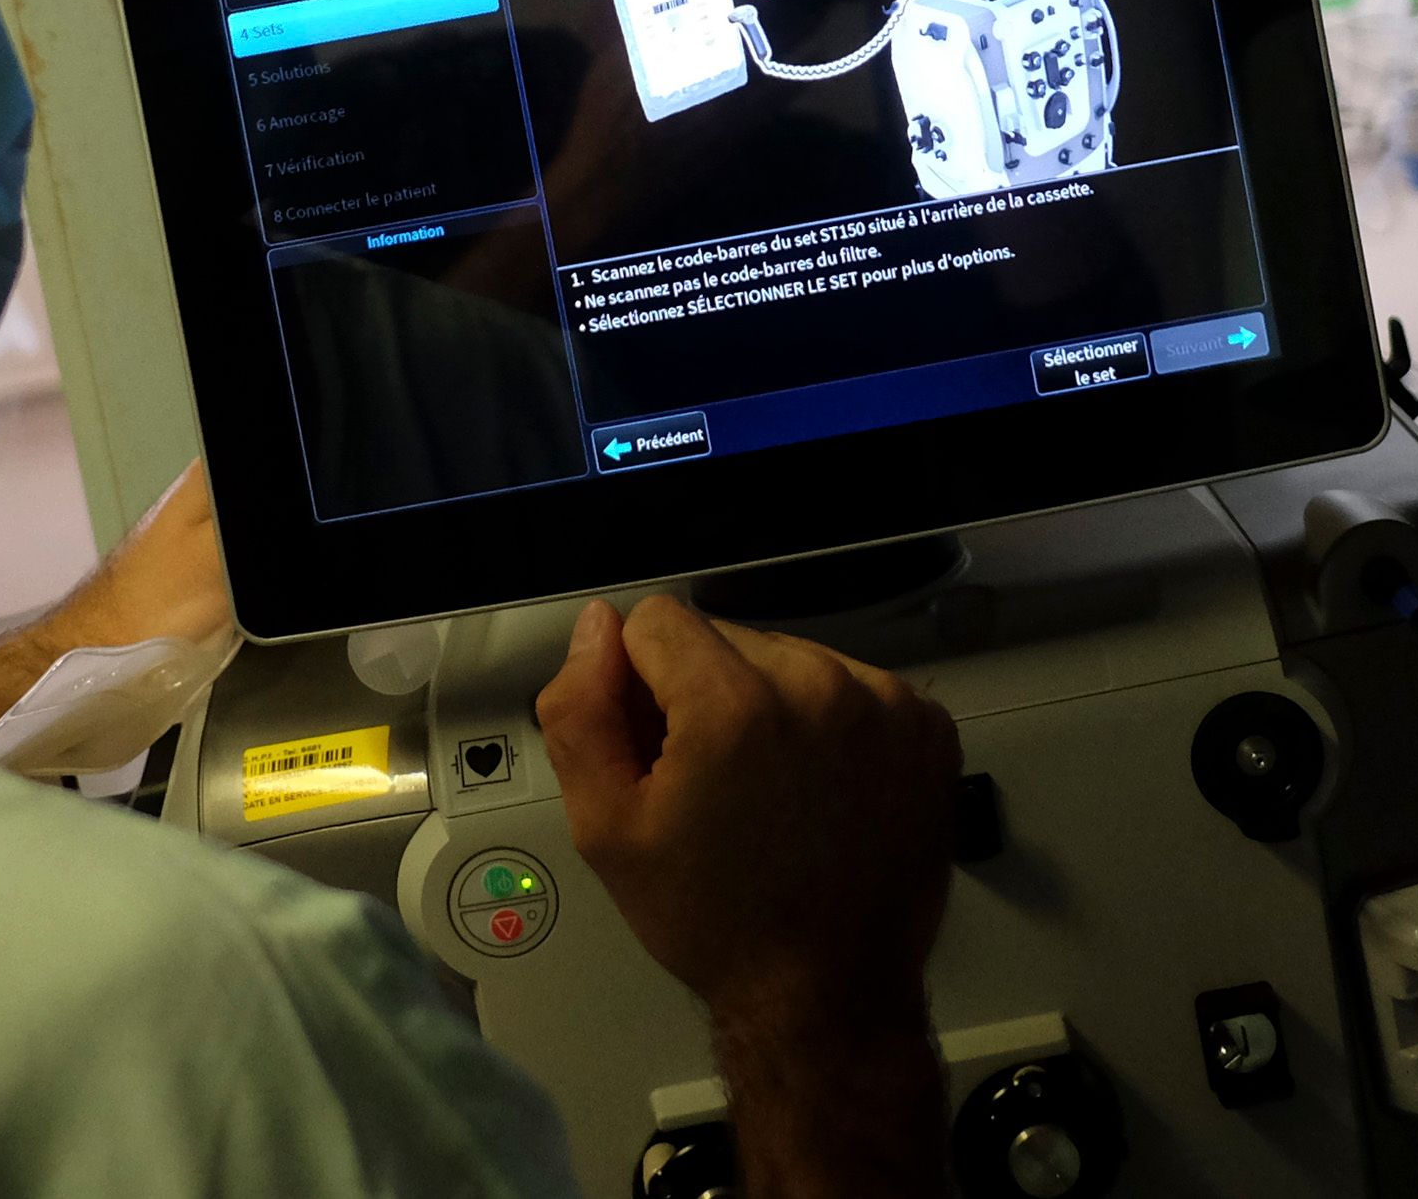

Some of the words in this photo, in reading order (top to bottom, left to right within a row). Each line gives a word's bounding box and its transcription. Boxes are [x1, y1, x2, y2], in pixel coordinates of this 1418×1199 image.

[240, 29, 250, 42] 4
[253, 22, 284, 39] Sets
[248, 72, 259, 87] 5
[260, 60, 332, 86] Solutions
[256, 117, 267, 132] 6
[265, 163, 275, 178] 7
[277, 148, 365, 176] Vérification
[273, 209, 283, 223] 8
[286, 196, 362, 221] Connecter
[365, 192, 380, 208] le
[383, 182, 437, 209] patient
[367, 224, 444, 249] Information
[570, 272, 585, 288] 1.
[591, 260, 656, 284] Scannez
[657, 255, 673, 273] le
[674, 239, 768, 269] code-barres
[770, 233, 792, 252] du
[794, 230, 819, 248] set
[820, 220, 866, 243] ST150
[868, 212, 906, 235] situé
[908, 209, 918, 227] à
[921, 200, 984, 225] l'arrière
[985, 196, 1006, 213] de
[1007, 192, 1024, 209] la
[1026, 182, 1094, 205] cassette.
[584, 293, 606, 310] Ne
[608, 282, 671, 306] scannez
[673, 278, 701, 298] pas
[703, 271, 718, 289] le
[720, 256, 814, 286] code-barres
[816, 250, 838, 268] du
[839, 245, 882, 265] filtre.
[588, 304, 685, 333] Sélectionnez
[687, 282, 805, 313] SÉLECTIONNER
[807, 277, 827, 294] LE
[829, 271, 858, 291] SET
[861, 267, 898, 288] pour
[901, 258, 935, 281] plus
[937, 245, 1016, 272] d'options.
[1043, 339, 1139, 368] Sélectionner
[1166, 336, 1224, 358] Suivant
[1074, 369, 1090, 386] le
[1092, 366, 1117, 383] set
[636, 428, 705, 452] Précédent
[269, 795, 281, 805] EN
